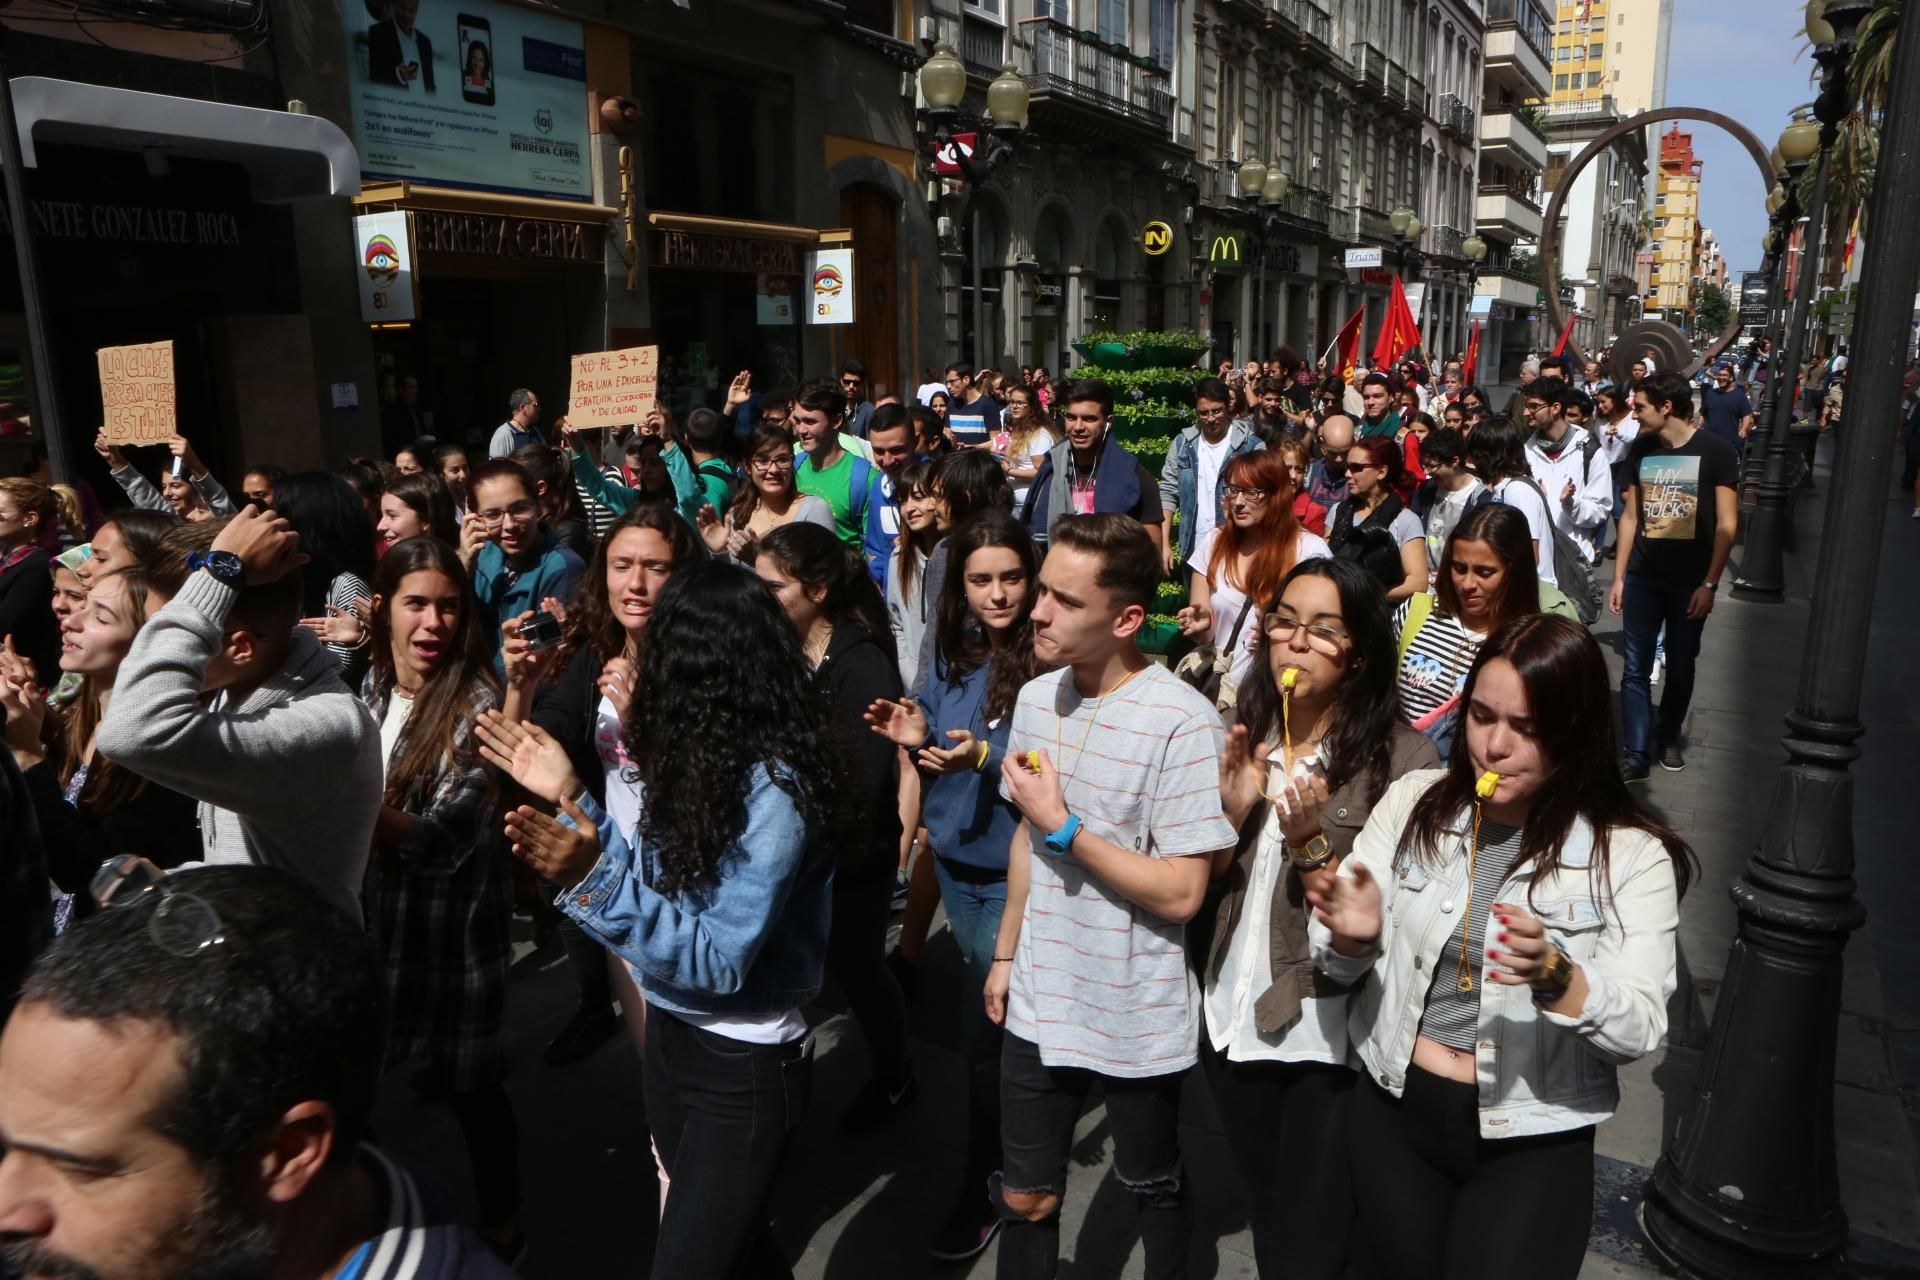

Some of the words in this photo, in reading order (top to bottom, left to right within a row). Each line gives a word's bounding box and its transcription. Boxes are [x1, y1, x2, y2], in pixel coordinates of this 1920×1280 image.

[365, 121, 380, 131] 2x1
[511, 142, 551, 155] HERRERA
[553, 147, 580, 159] CERPA
[92, 204, 192, 243] GONZALEZ
[196, 210, 241, 246] ROCA
[516, 219, 586, 259] CERPA
[1349, 252, 1380, 262] Triana
[818, 303, 831, 316] 80
[103, 349, 124, 382] LA
[126, 347, 170, 379] CLASE
[579, 359, 594, 375] NO
[600, 357, 611, 371] AL
[576, 379, 593, 393] POR
[596, 378, 612, 390] UNA
[591, 408, 596, 416] Y
[599, 407, 609, 416] DE
[1654, 468, 1682, 484] MY
[1651, 485, 1682, 501] LIFE
[1643, 502, 1691, 518] ROCKS
